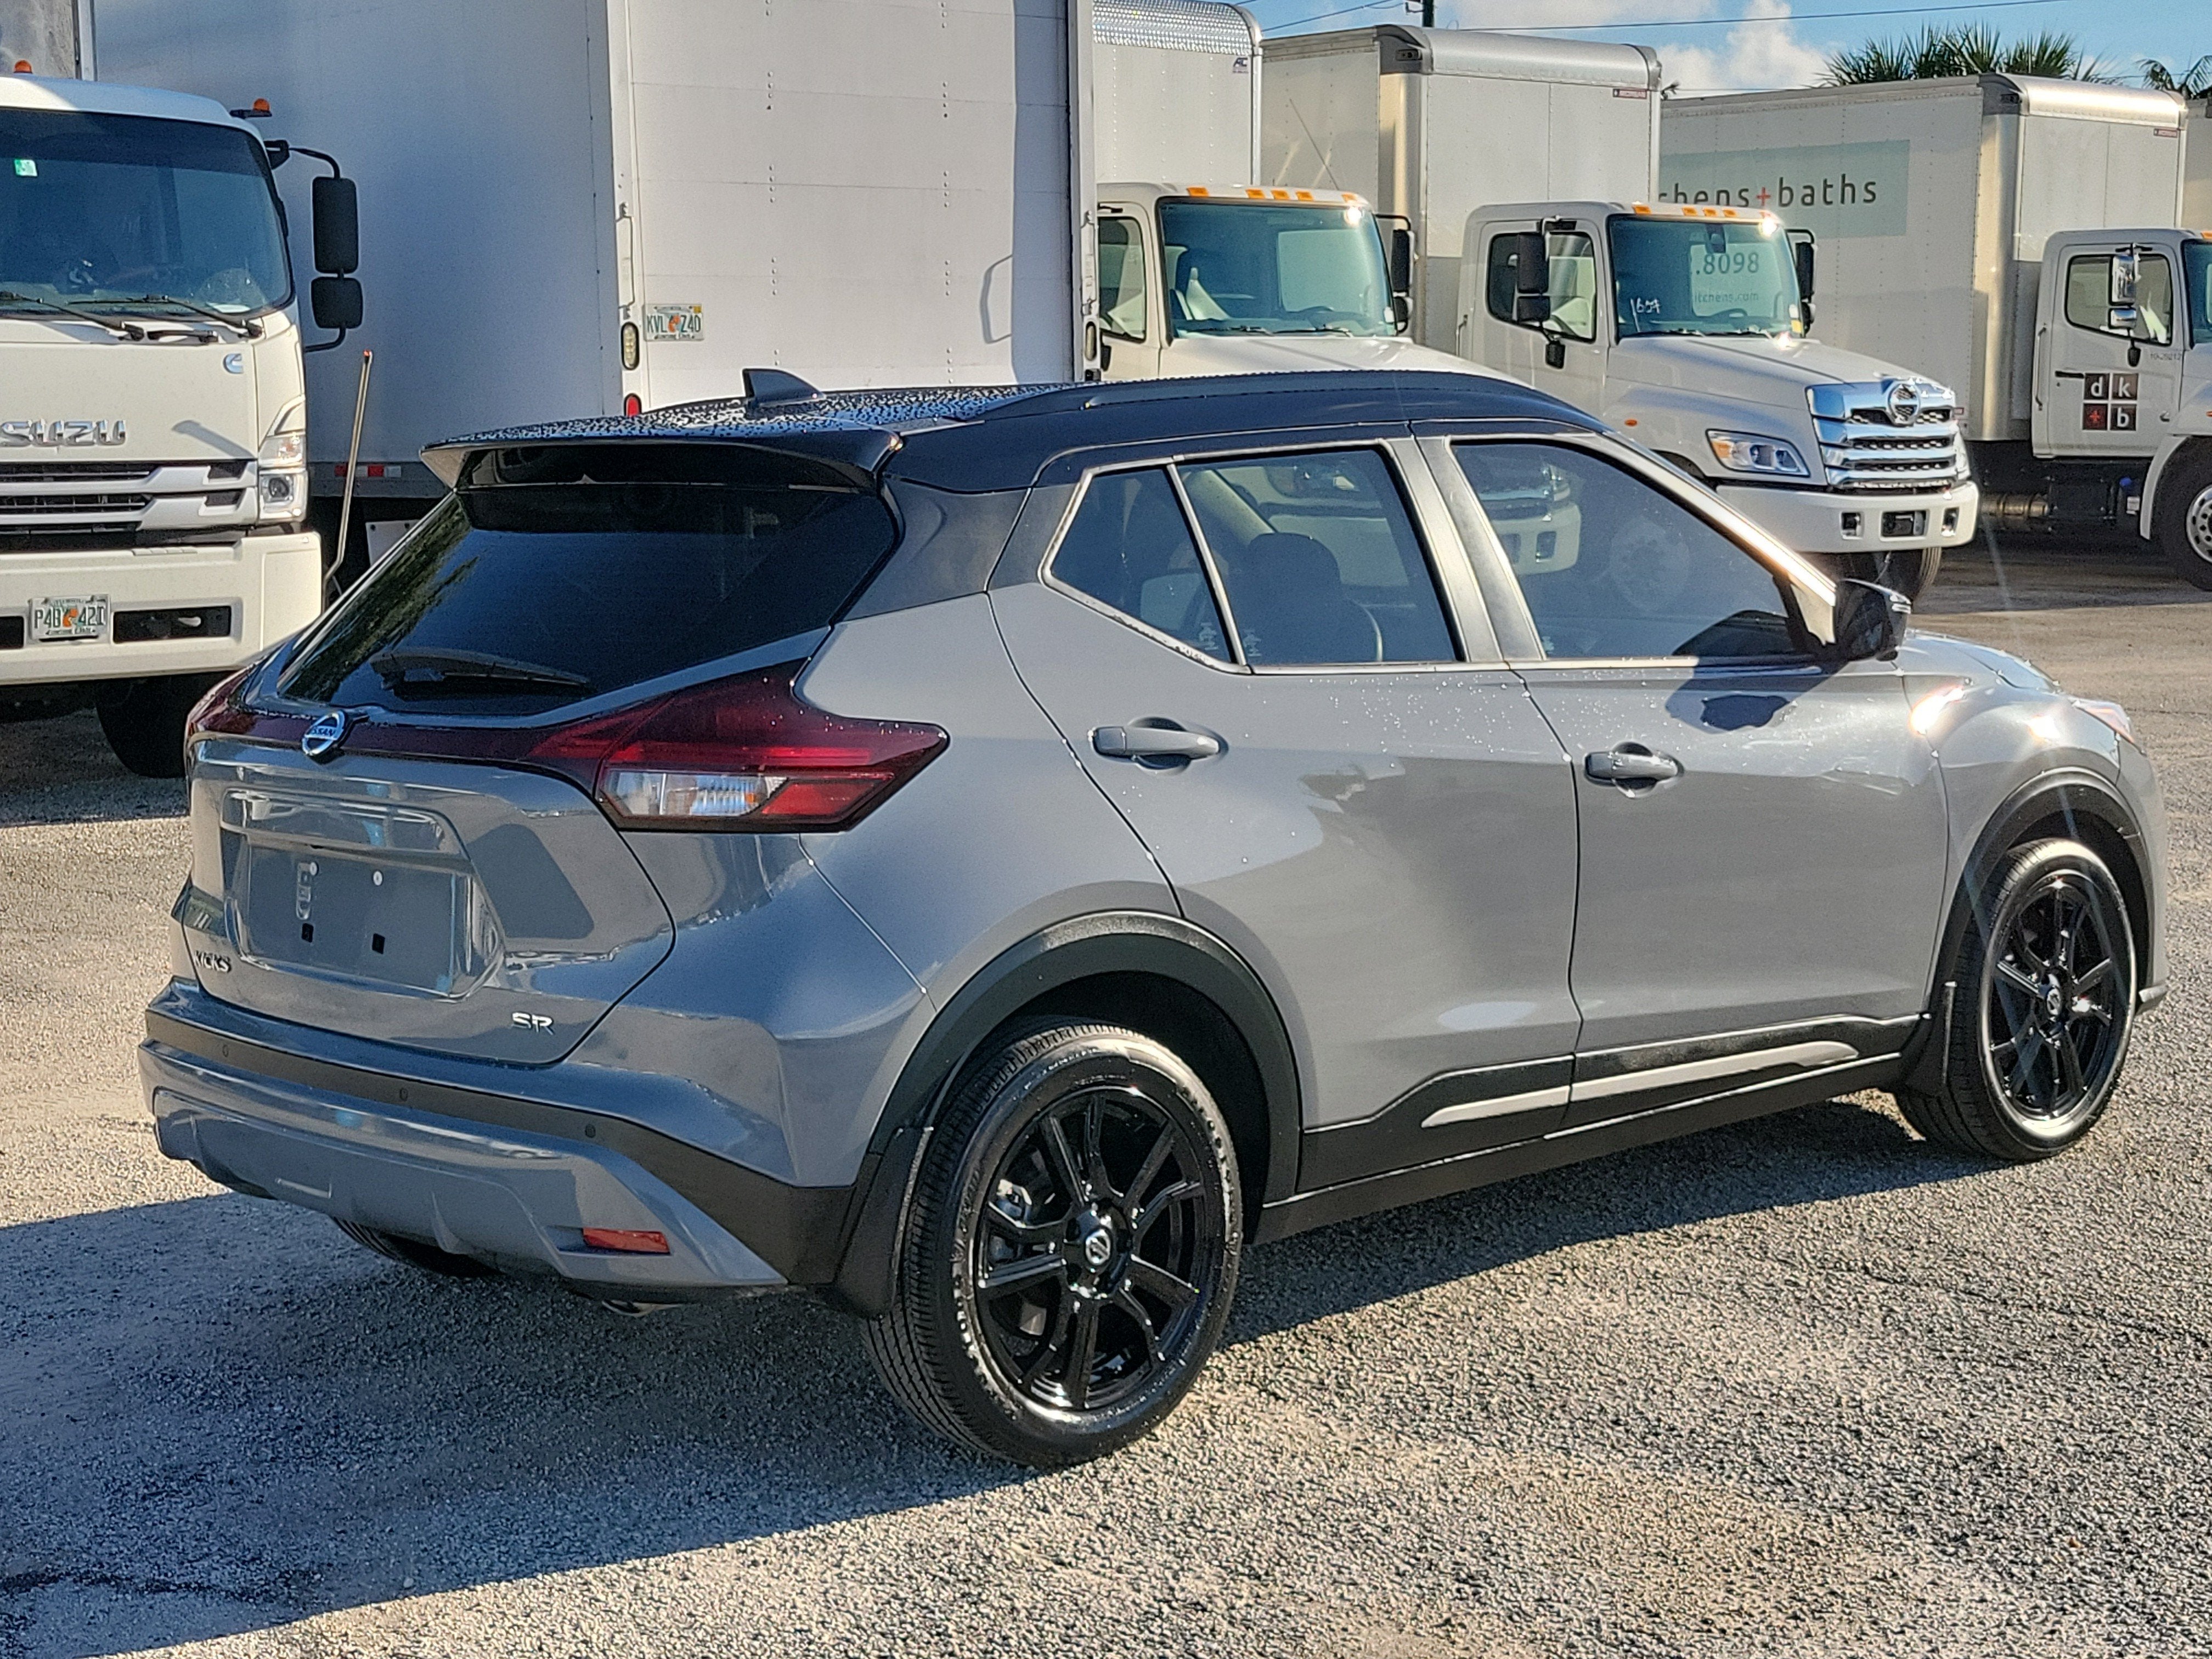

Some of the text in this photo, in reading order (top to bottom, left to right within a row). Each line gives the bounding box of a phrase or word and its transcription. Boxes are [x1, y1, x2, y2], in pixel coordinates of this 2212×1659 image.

[647, 315, 667, 333] KVL
[194, 950, 232, 973] KICKS
[511, 1011, 555, 1036] SR
